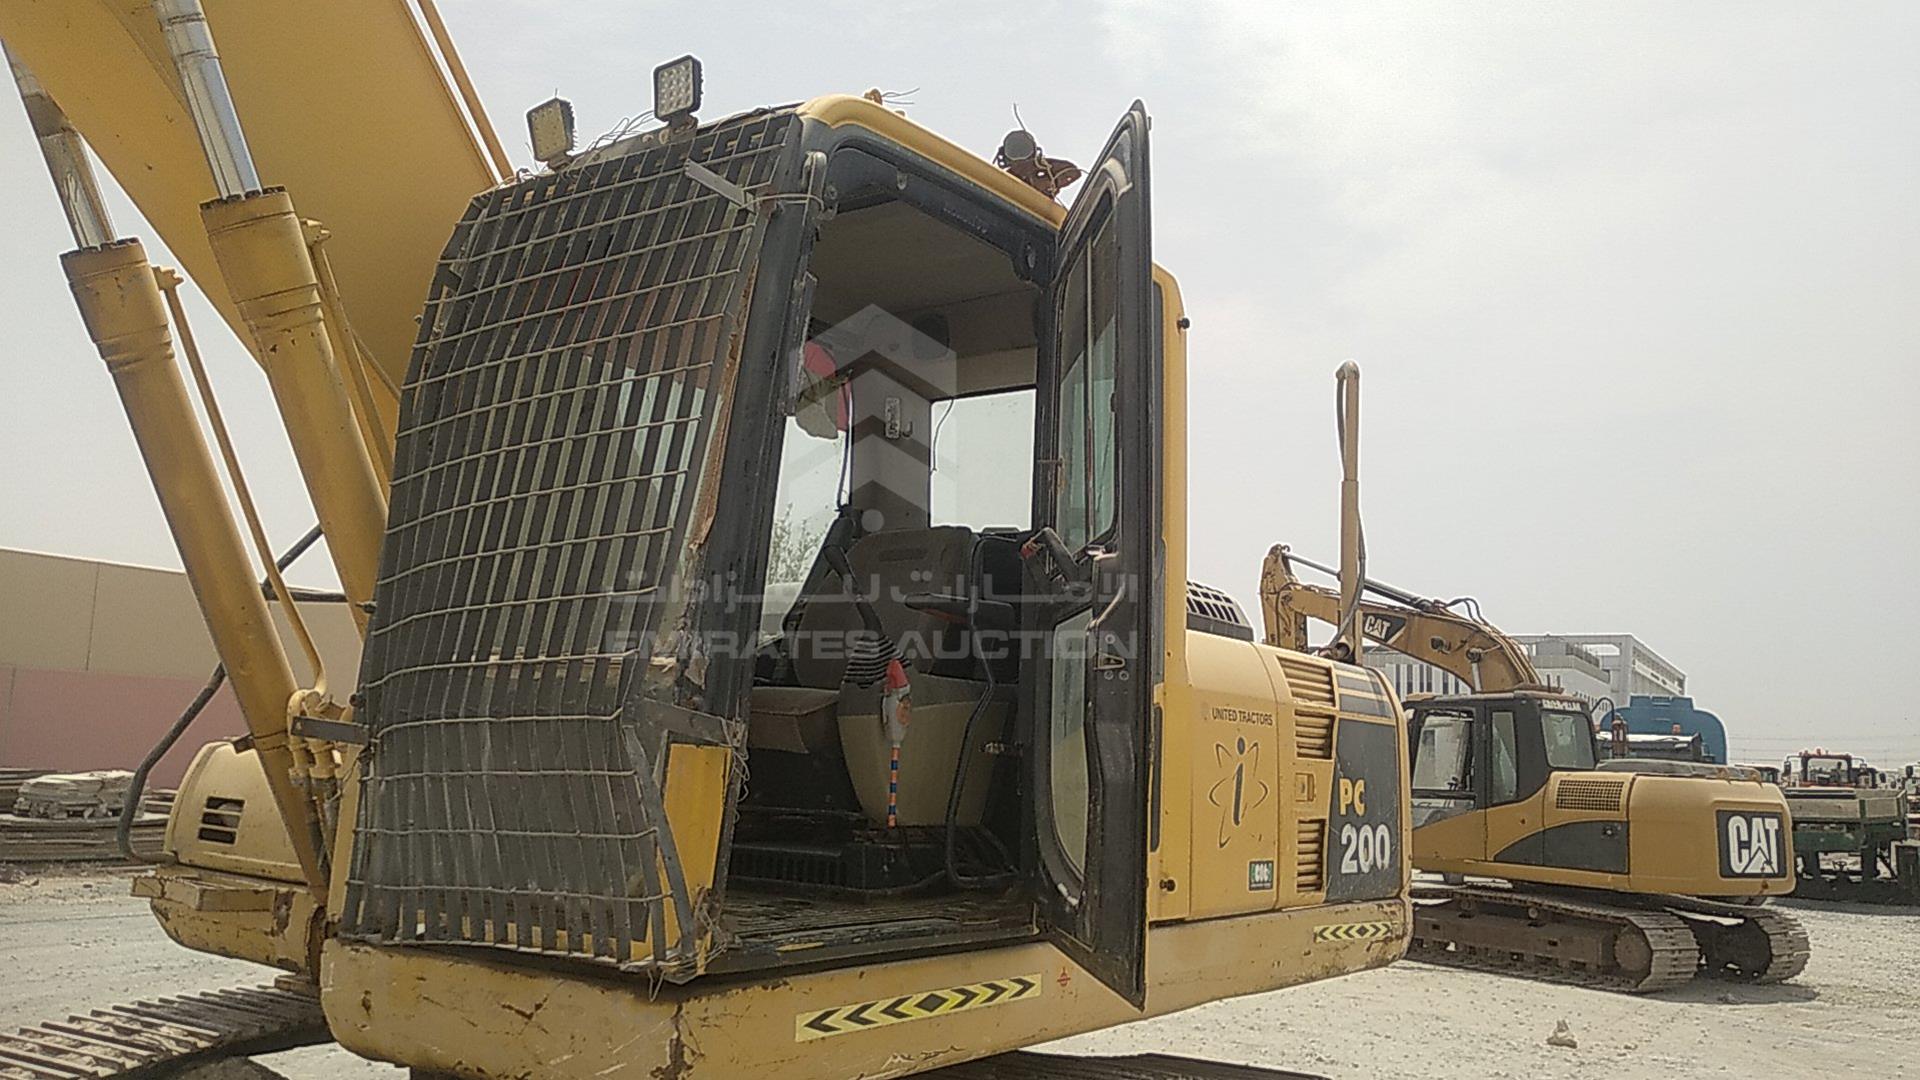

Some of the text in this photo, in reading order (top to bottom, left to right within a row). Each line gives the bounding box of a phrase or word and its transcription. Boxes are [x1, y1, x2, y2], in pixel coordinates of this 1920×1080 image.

[1364, 615, 1391, 639] CAT
[1211, 707, 1273, 726] UNITED TRACTORS
[1339, 778, 1366, 816] PC
[1340, 823, 1391, 874] 200
[1727, 815, 1779, 874] CAT
